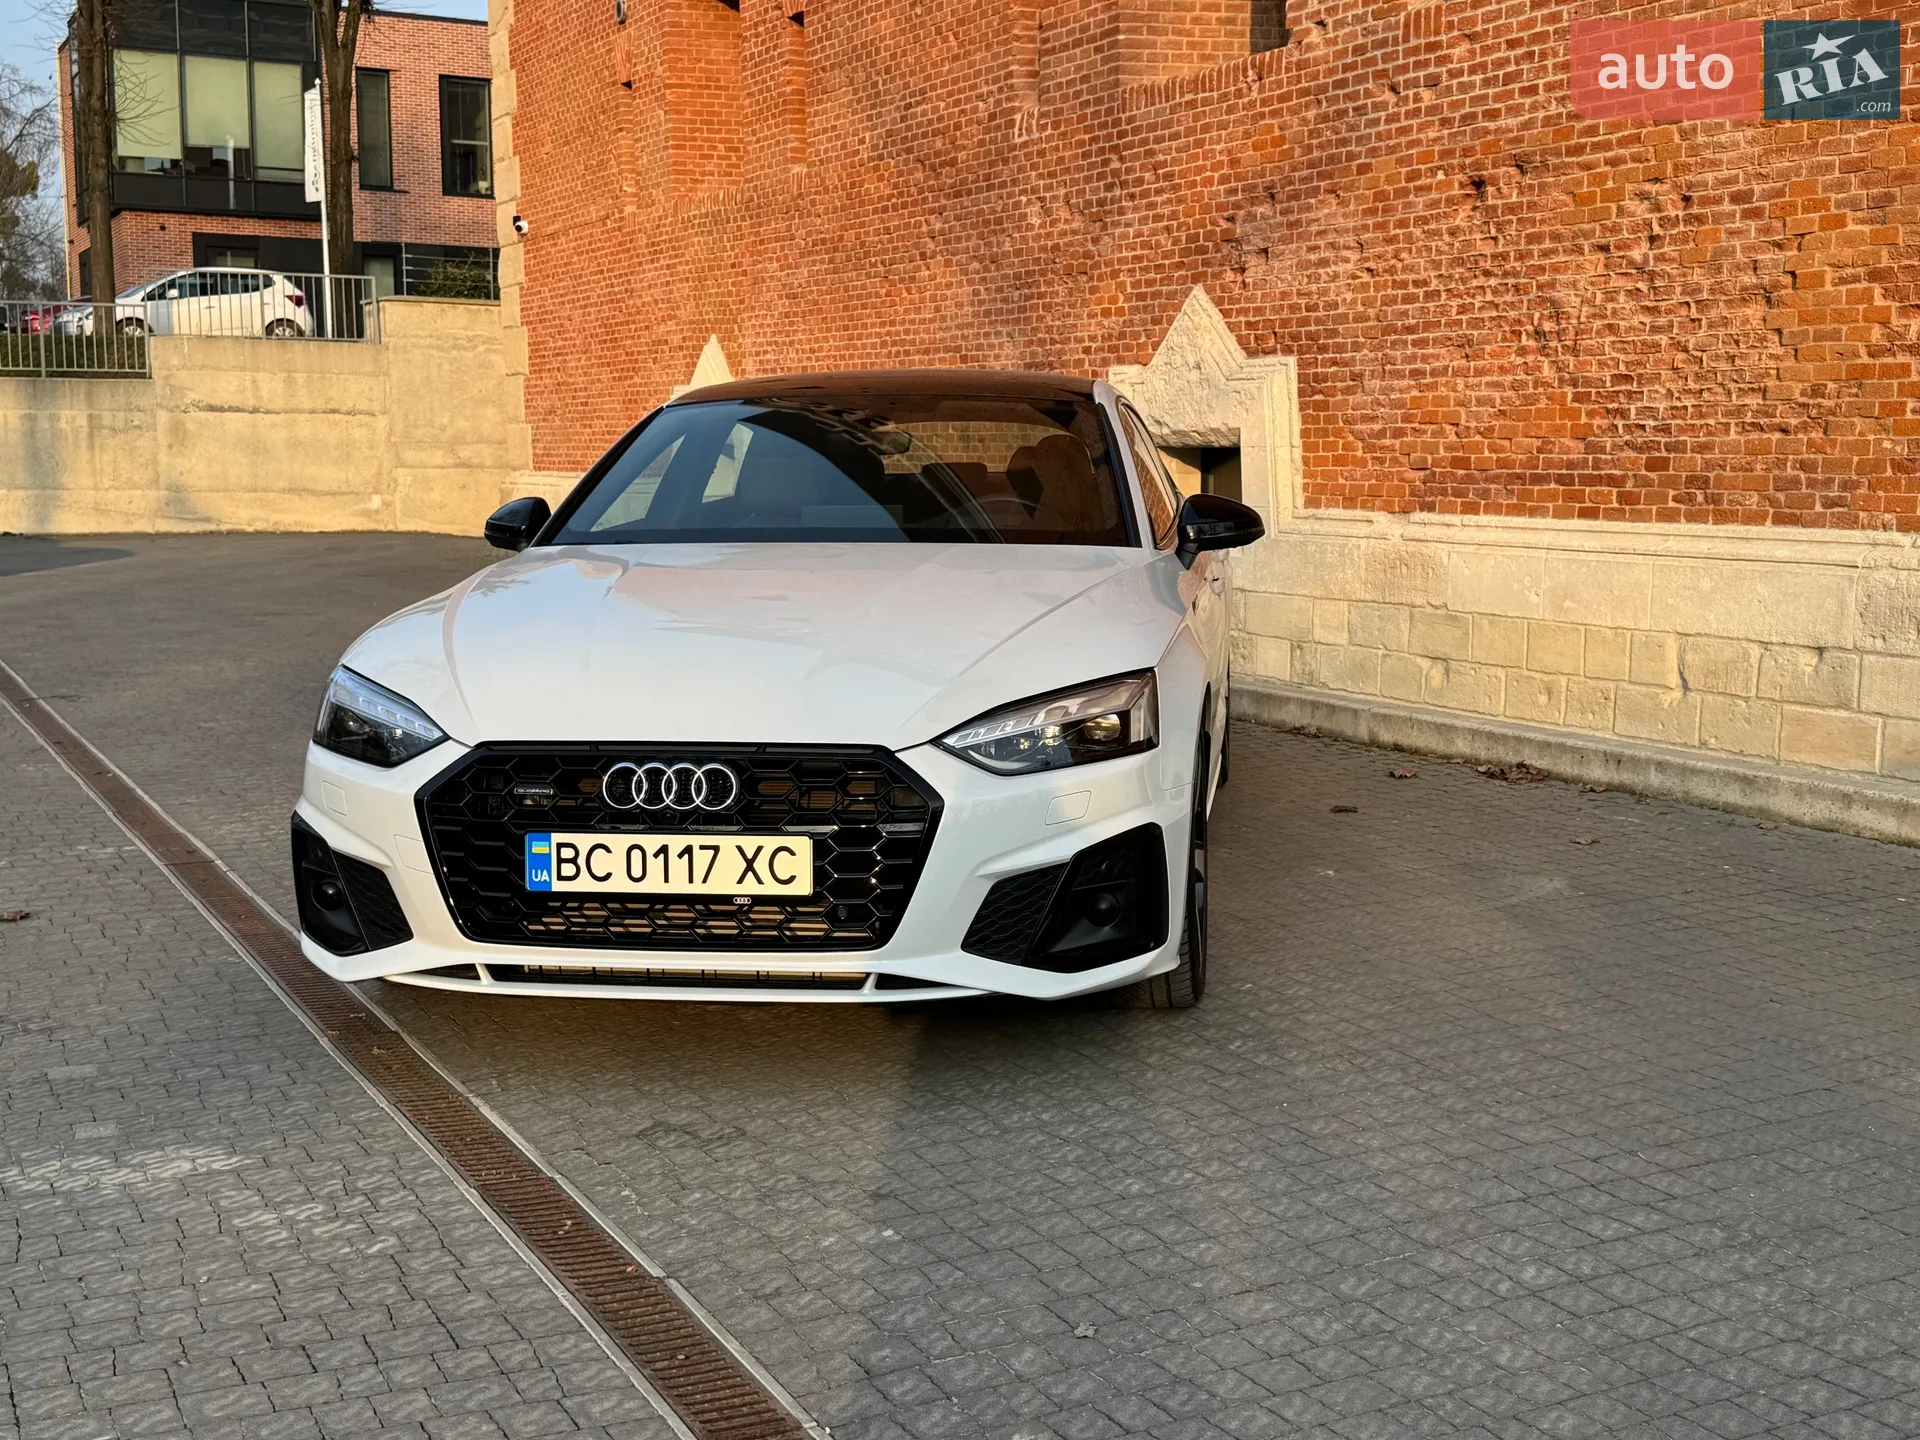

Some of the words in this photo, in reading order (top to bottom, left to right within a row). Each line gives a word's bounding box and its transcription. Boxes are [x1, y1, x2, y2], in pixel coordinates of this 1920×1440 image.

[532, 869, 550, 882] UA
[556, 842, 613, 882] BC
[626, 843, 721, 884] 0117
[735, 845, 797, 885] XC
